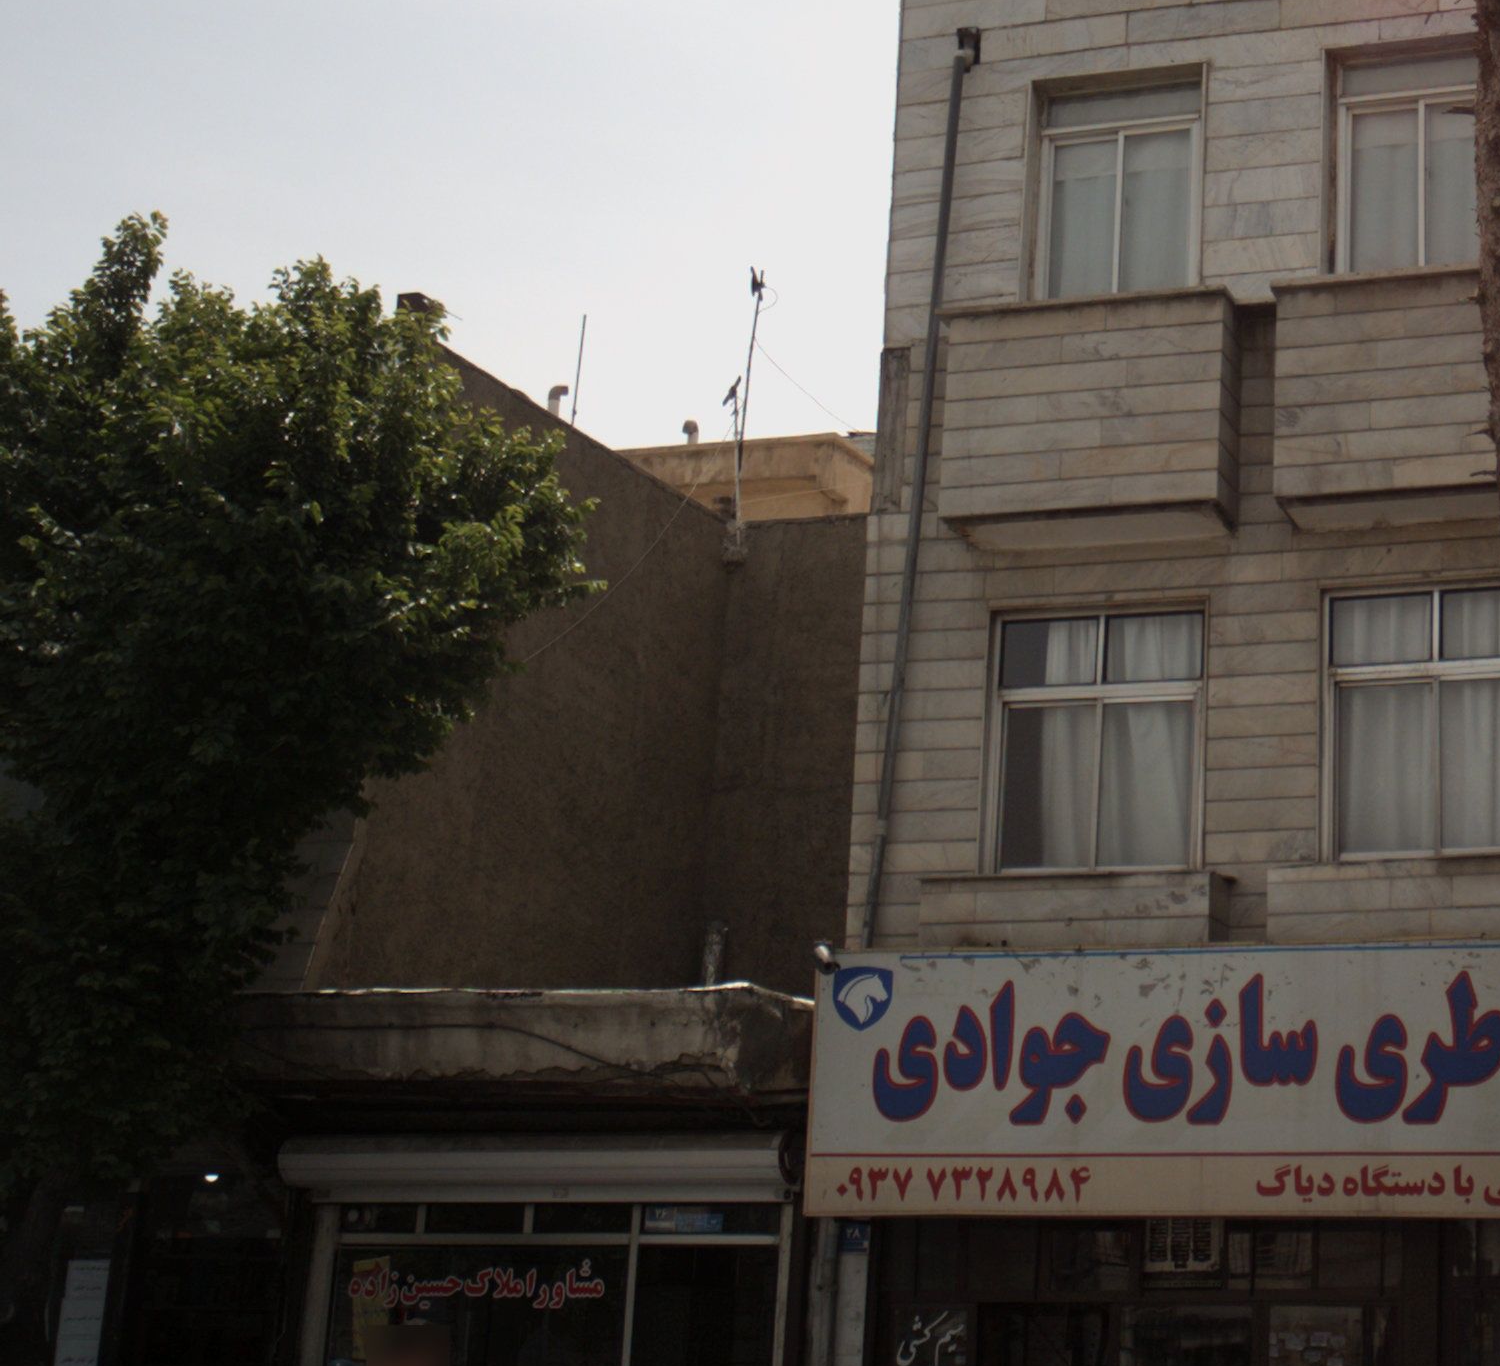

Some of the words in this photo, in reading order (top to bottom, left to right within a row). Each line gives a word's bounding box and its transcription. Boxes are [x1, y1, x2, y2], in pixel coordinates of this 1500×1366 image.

[872, 980, 1111, 1125] جوادی
[1123, 973, 1318, 1125] سازی
[836, 1166, 913, 1201] ۰۹۳۷
[926, 1166, 1092, 1202] ۷۳۲۸۹۸۴
[1256, 1163, 1335, 1203] دیاگ
[1342, 1164, 1446, 1197] دستگاه
[1453, 1164, 1475, 1204] با
[463, 1266, 537, 1299] املاک
[533, 1257, 606, 1309] مشاور
